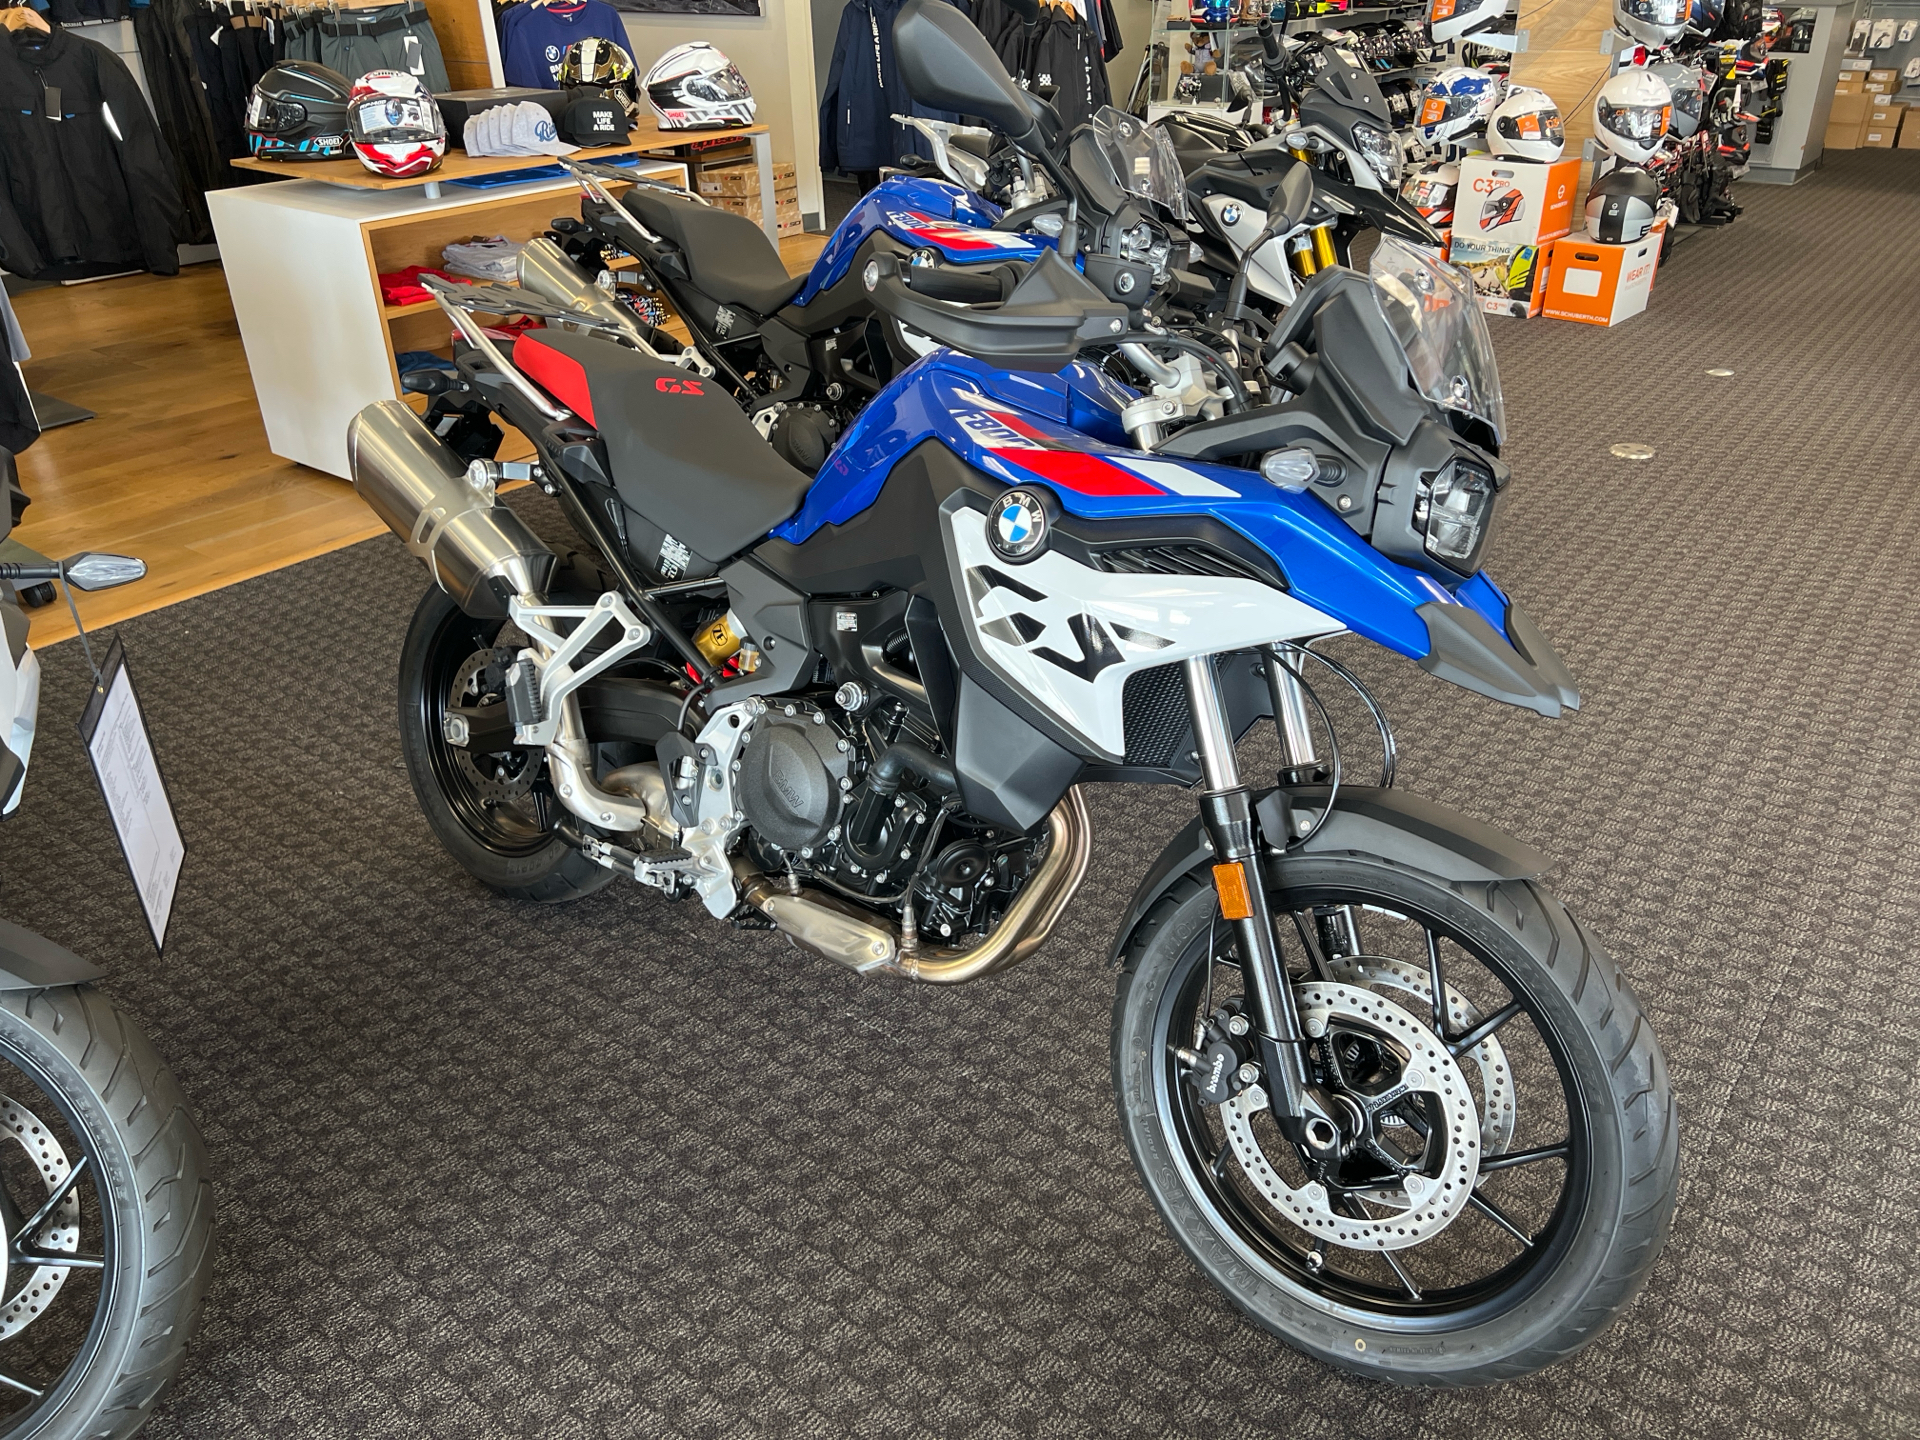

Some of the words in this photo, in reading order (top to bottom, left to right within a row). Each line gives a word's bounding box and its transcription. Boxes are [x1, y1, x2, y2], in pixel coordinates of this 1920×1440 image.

[549, 62, 563, 74] BM
[592, 111, 614, 119] MAKE
[667, 111, 685, 119] SHOEI
[592, 124, 600, 132] A
[600, 124, 615, 132] RIDE
[318, 138, 341, 147] SHOEI
[1472, 178, 1494, 194] C3
[1494, 180, 1511, 188] PRO
[1454, 241, 1465, 249] DO
[1466, 243, 1487, 252] YOUR
[1488, 245, 1511, 254] THING
[1625, 266, 1643, 283] WEAR
[1486, 301, 1499, 311] C3
[1545, 308, 1609, 324] WWW.SCHUBERTH.COM
[655, 376, 705, 396] GS
[711, 625, 727, 644] ZF
[772, 769, 805, 809] BMW
[1206, 1052, 1225, 1094] brembo
[1140, 1119, 1160, 1161] RADIAL
[1155, 1165, 1257, 1292] MAXXIS
